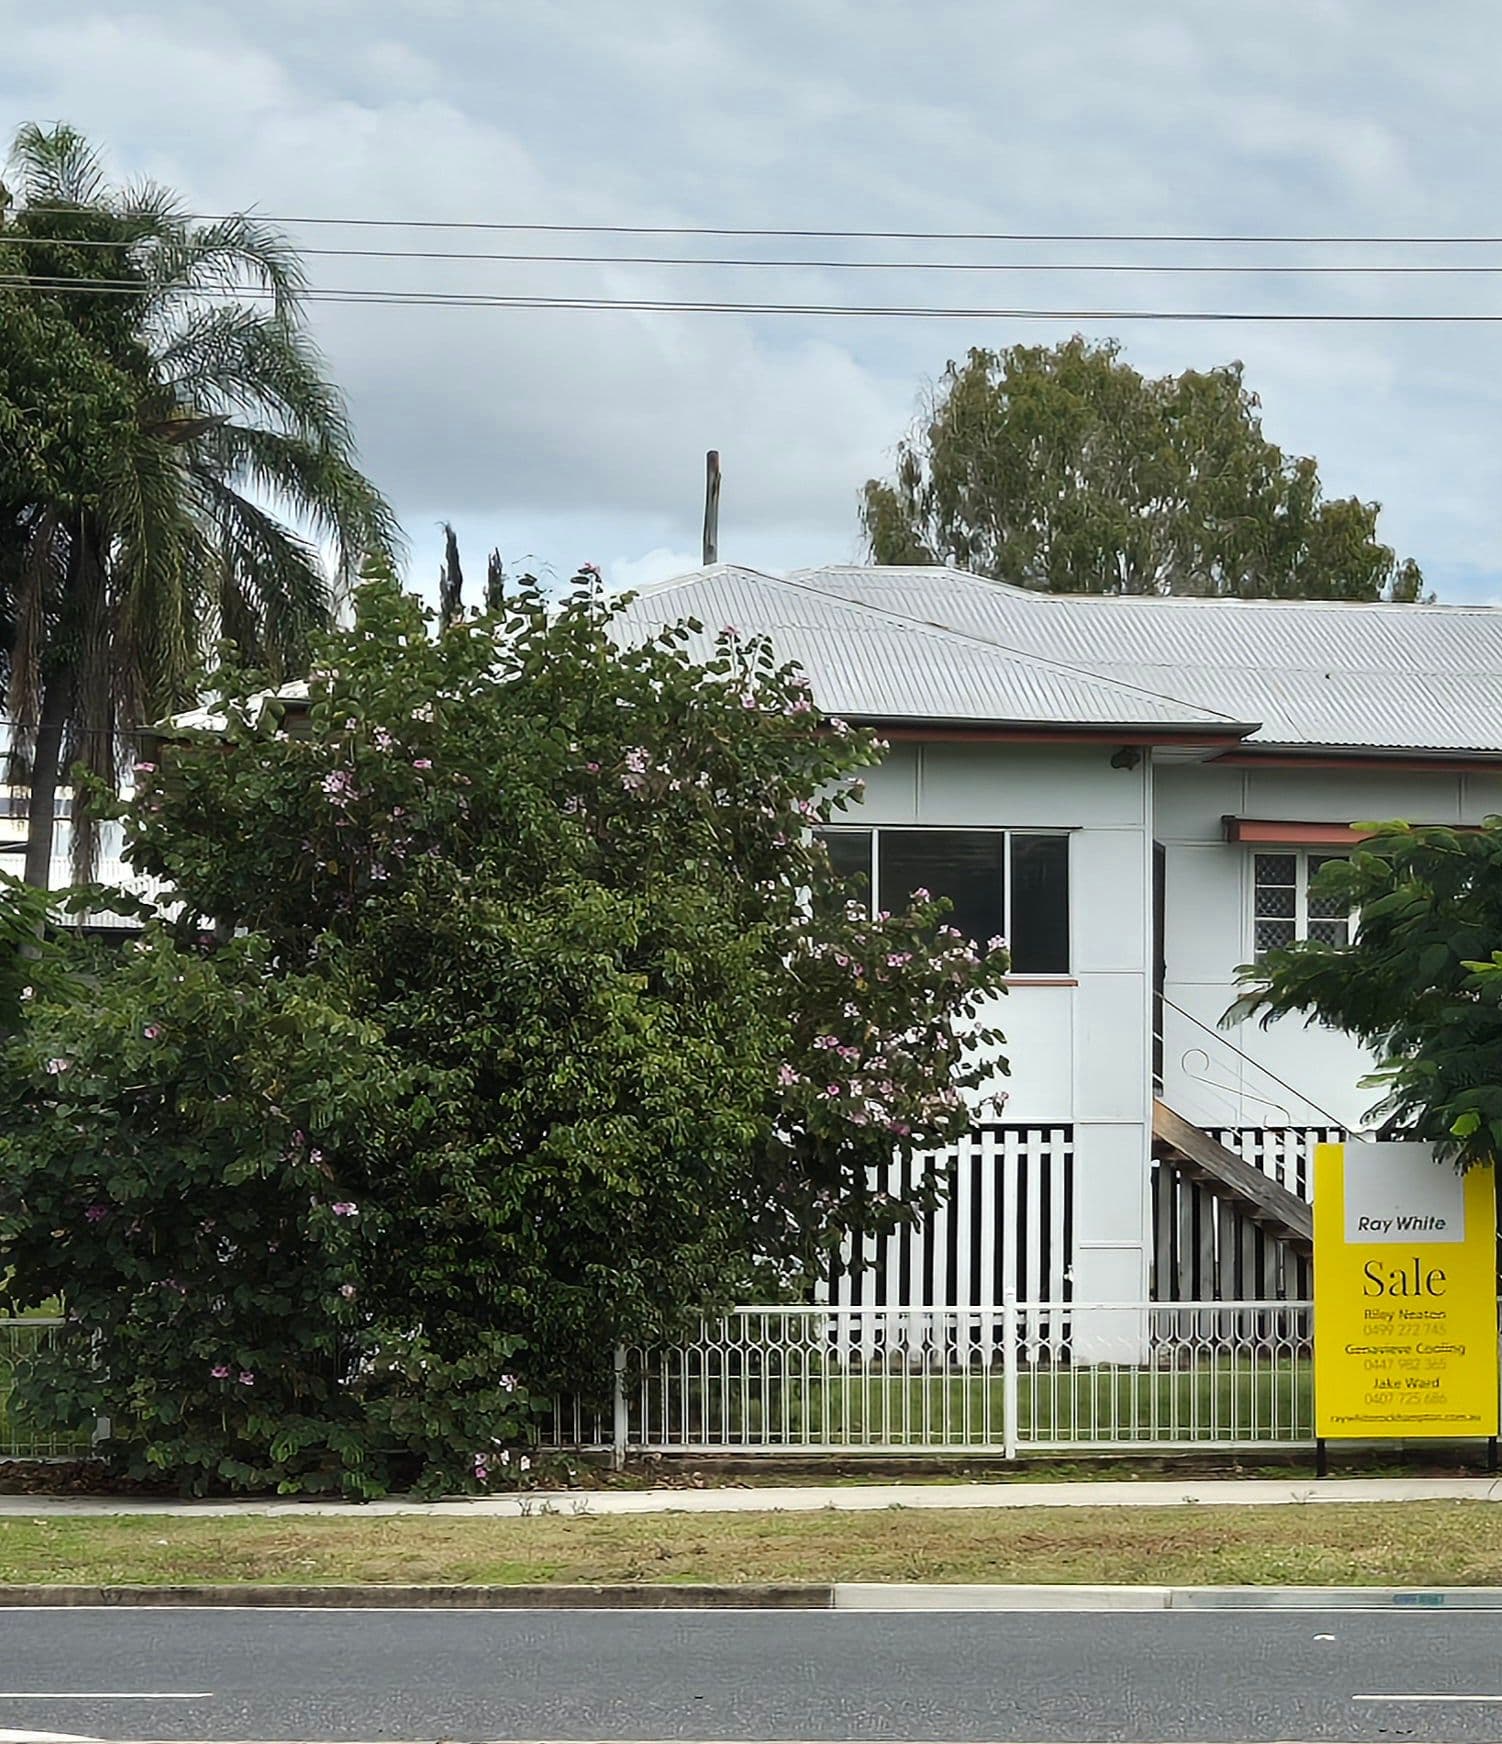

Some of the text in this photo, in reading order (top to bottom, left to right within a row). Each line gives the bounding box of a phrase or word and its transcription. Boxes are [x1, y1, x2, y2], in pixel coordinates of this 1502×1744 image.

[1358, 1216, 1447, 1234] Ray White
[1363, 1257, 1447, 1297] Sale
[1364, 1309, 1395, 1322] Riley
[1373, 1378, 1441, 1390] Jake Ward
